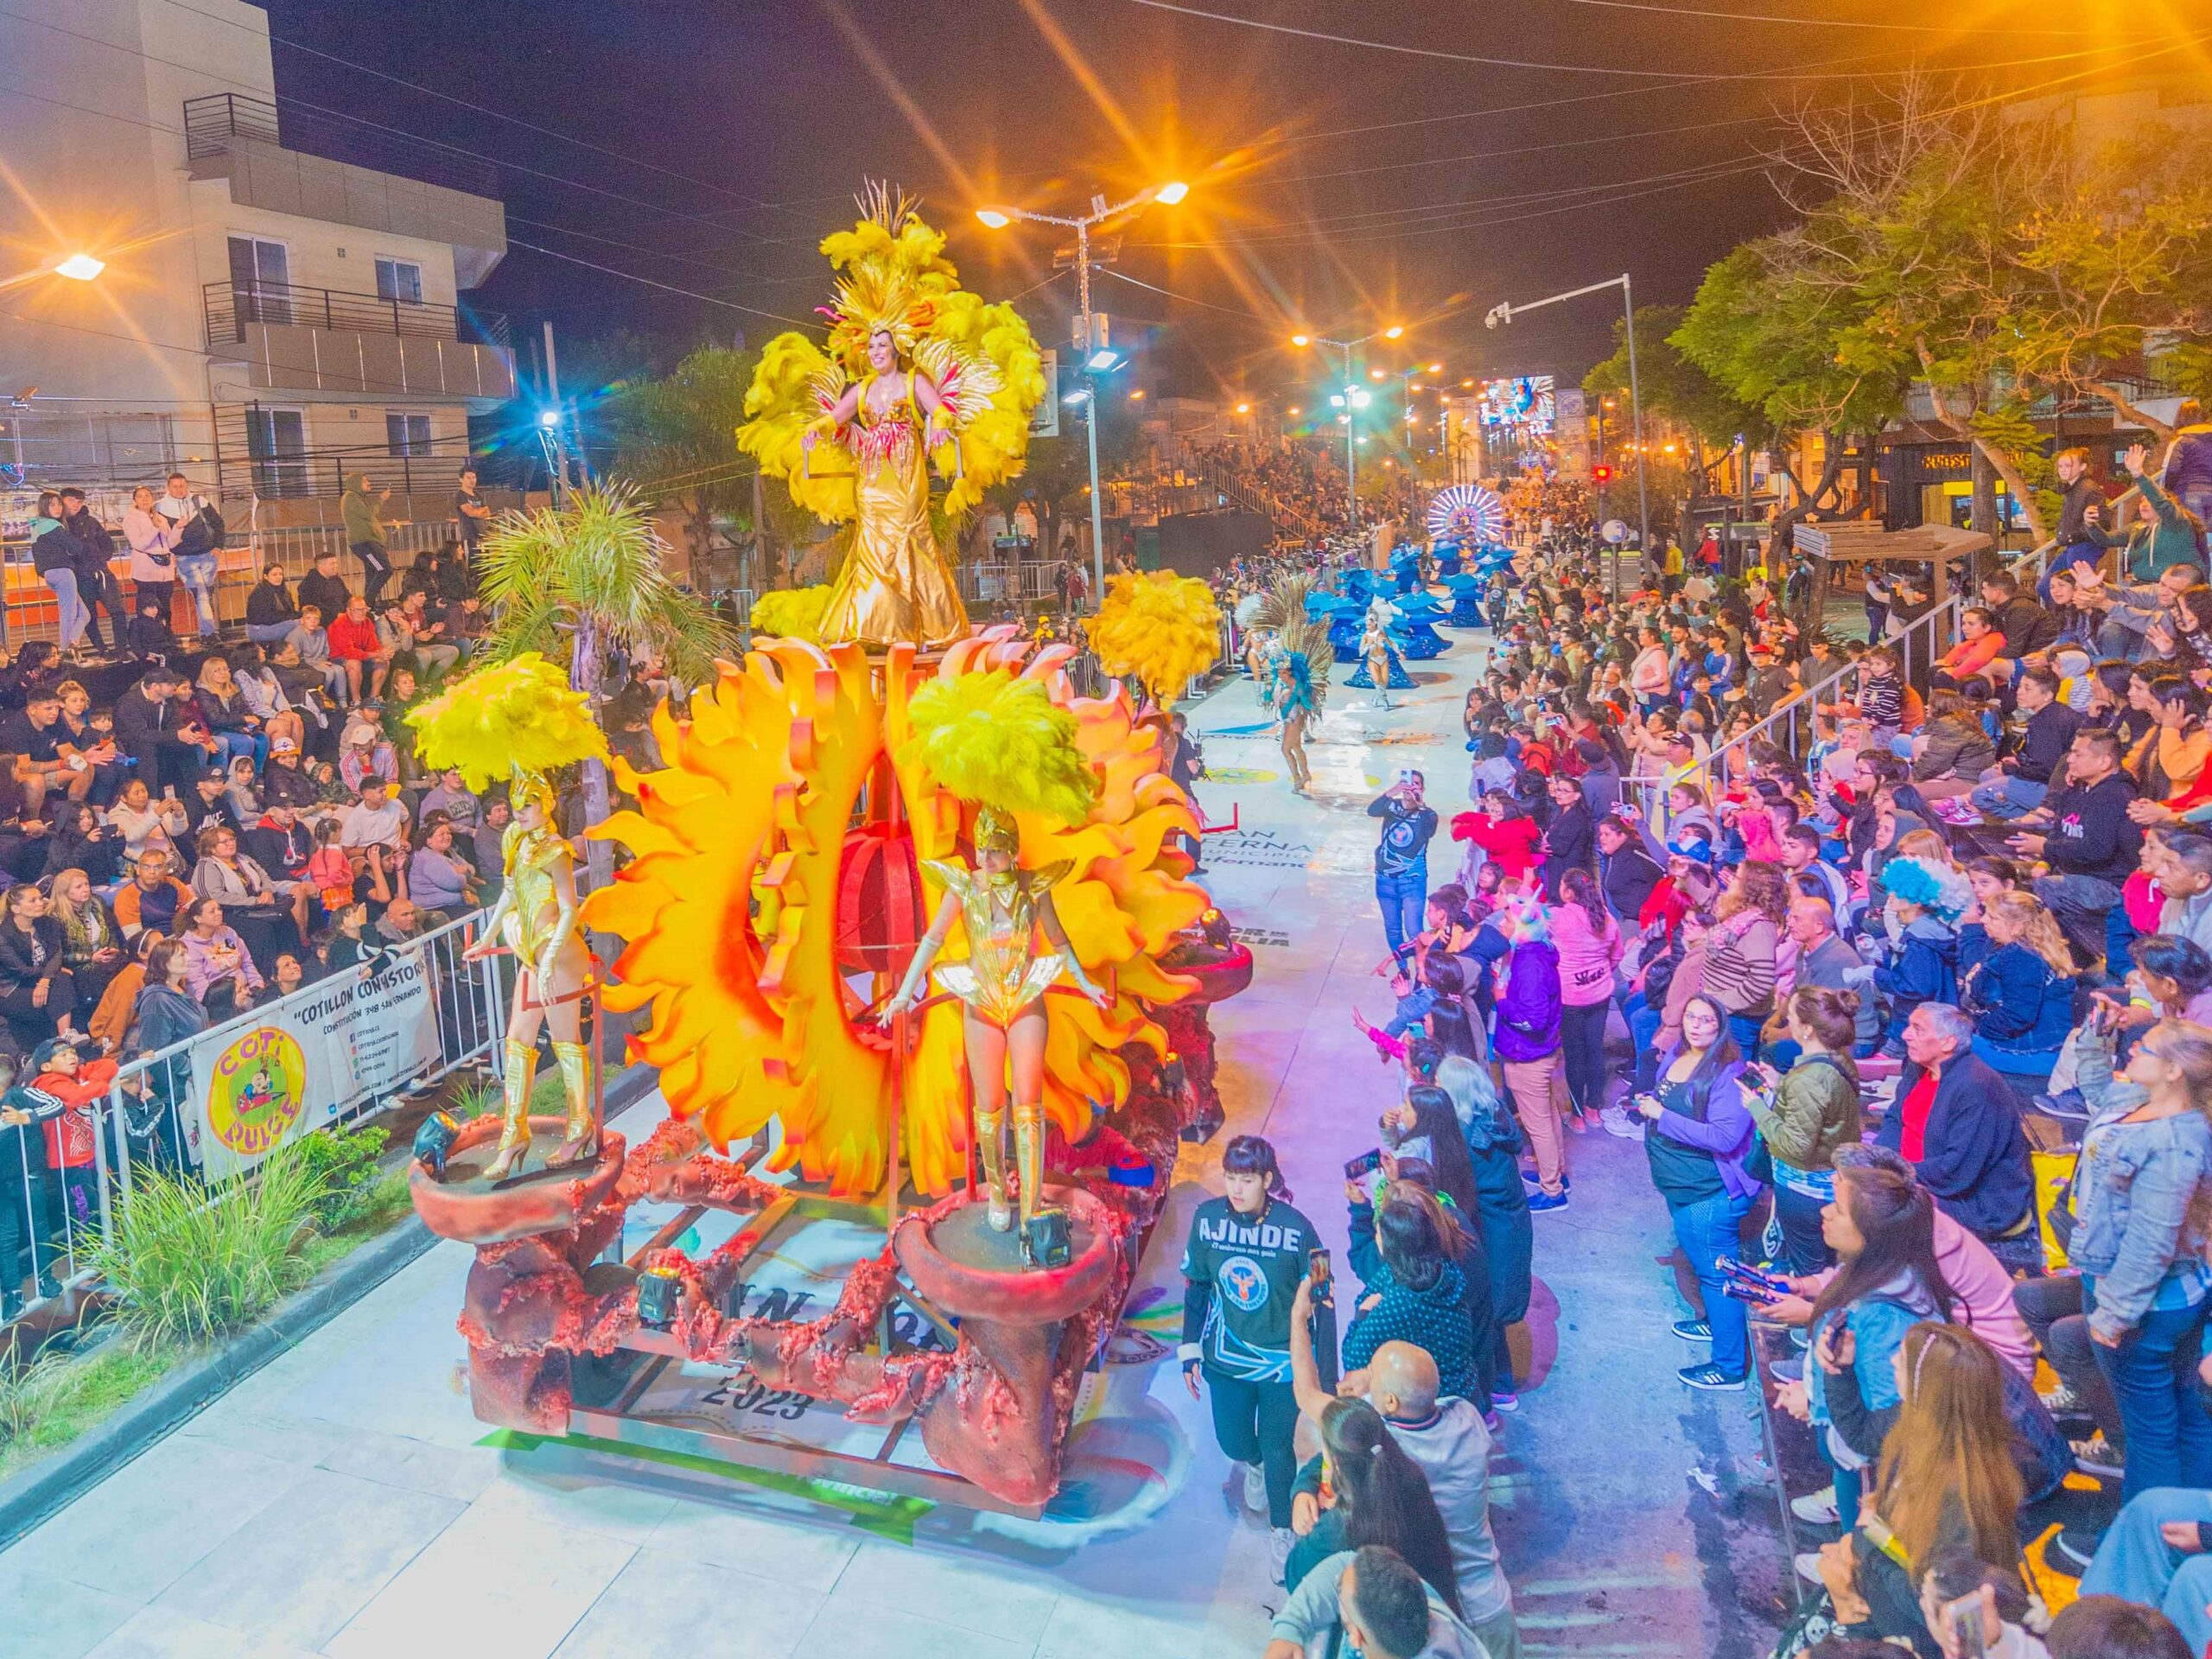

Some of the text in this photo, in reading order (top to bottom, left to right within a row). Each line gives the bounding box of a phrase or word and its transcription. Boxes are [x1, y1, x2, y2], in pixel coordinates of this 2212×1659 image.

[393, 985, 422, 1005] ERNANDO
[1198, 1217, 1301, 1253] AJINDE
[702, 1376, 817, 1420] 2023
